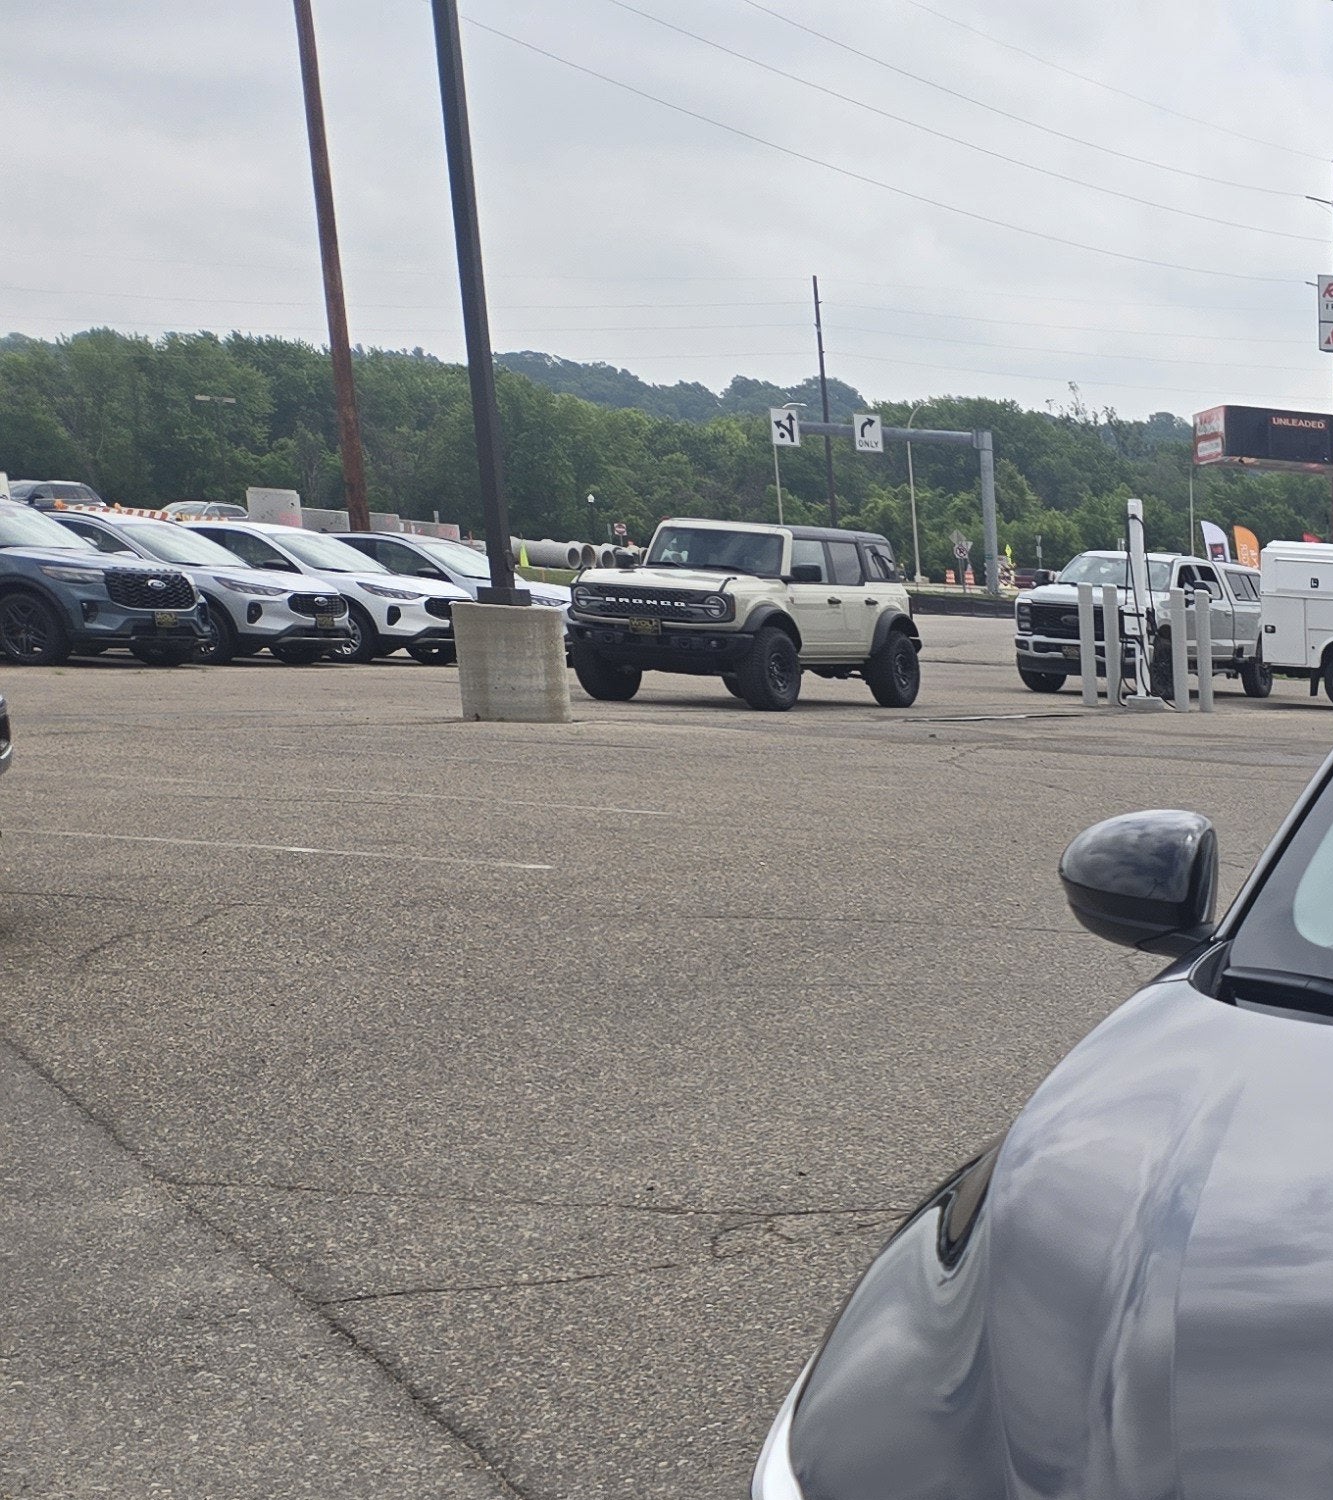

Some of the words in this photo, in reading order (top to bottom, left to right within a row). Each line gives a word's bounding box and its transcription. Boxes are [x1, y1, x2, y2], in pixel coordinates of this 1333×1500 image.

[1272, 416, 1325, 429] UNLEADED
[858, 438, 880, 449] ONLY
[605, 596, 686, 607] BRONCO
